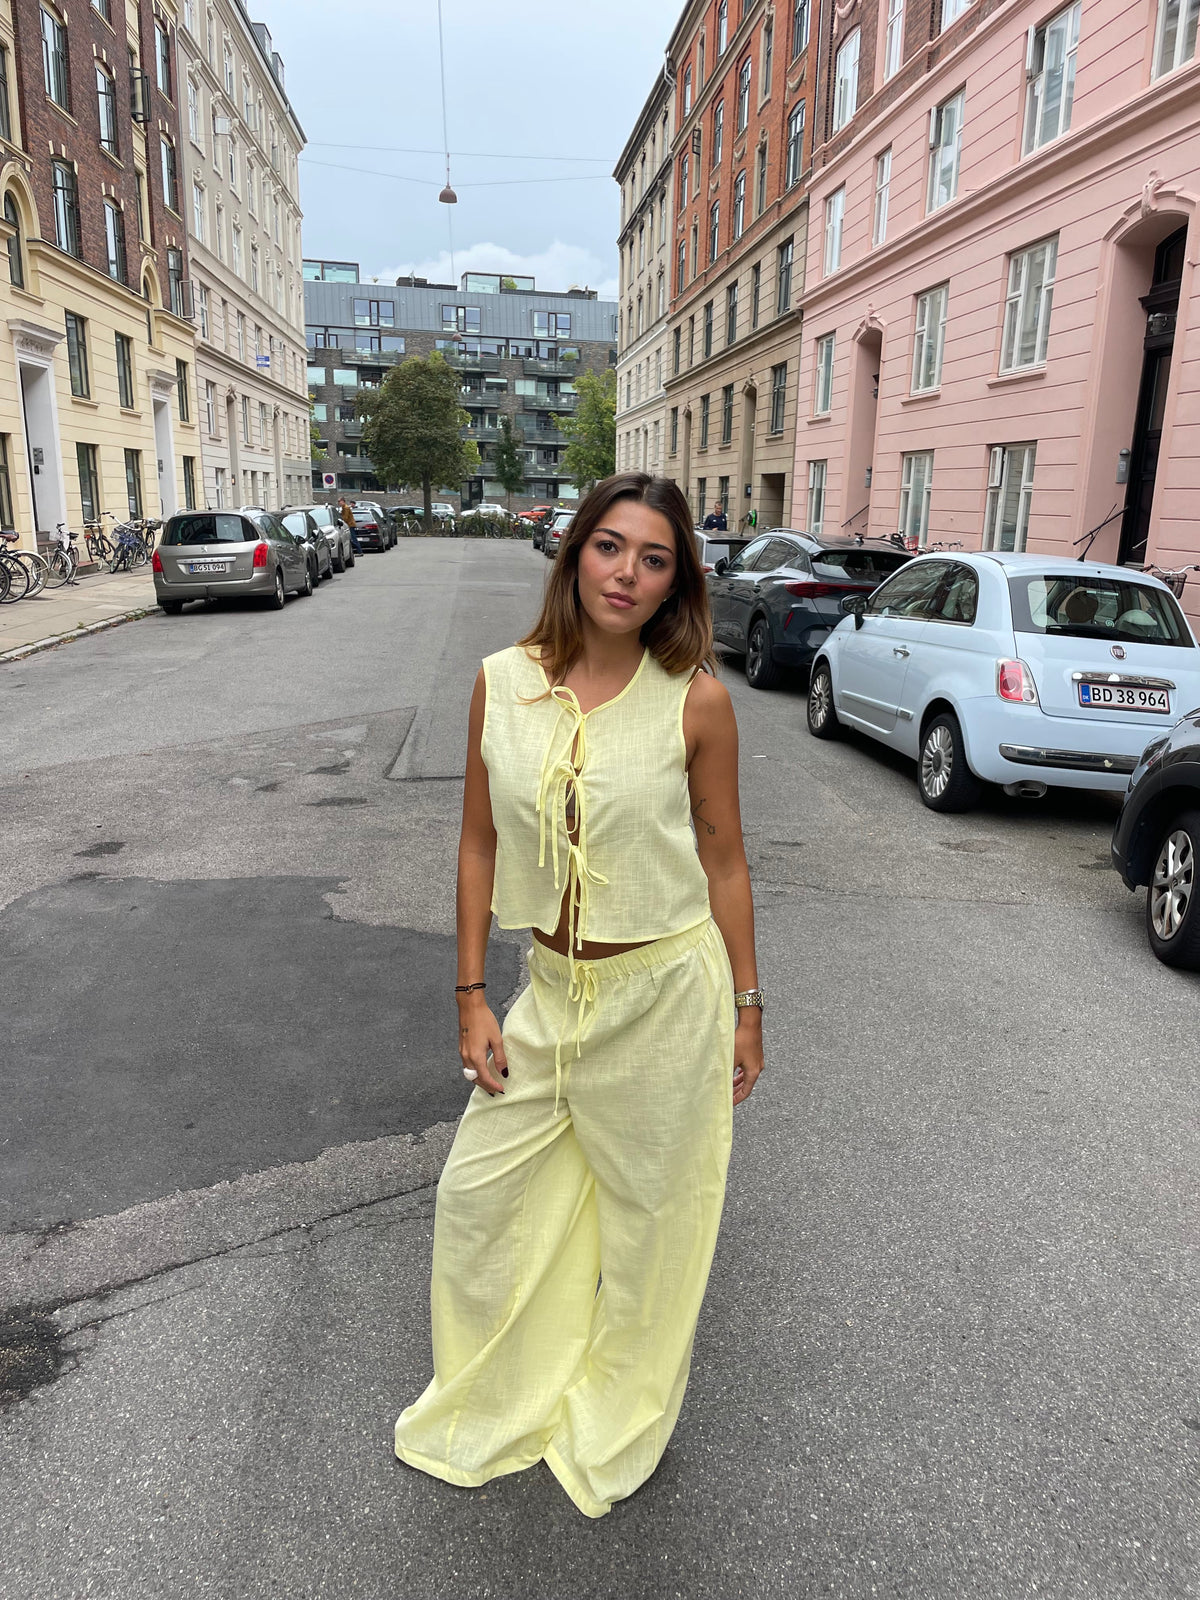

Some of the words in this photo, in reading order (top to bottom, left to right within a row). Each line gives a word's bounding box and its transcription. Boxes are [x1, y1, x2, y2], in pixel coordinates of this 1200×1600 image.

[1092, 687, 1112, 702] BD
[1116, 689, 1135, 705] 38
[1138, 691, 1166, 708] 964
